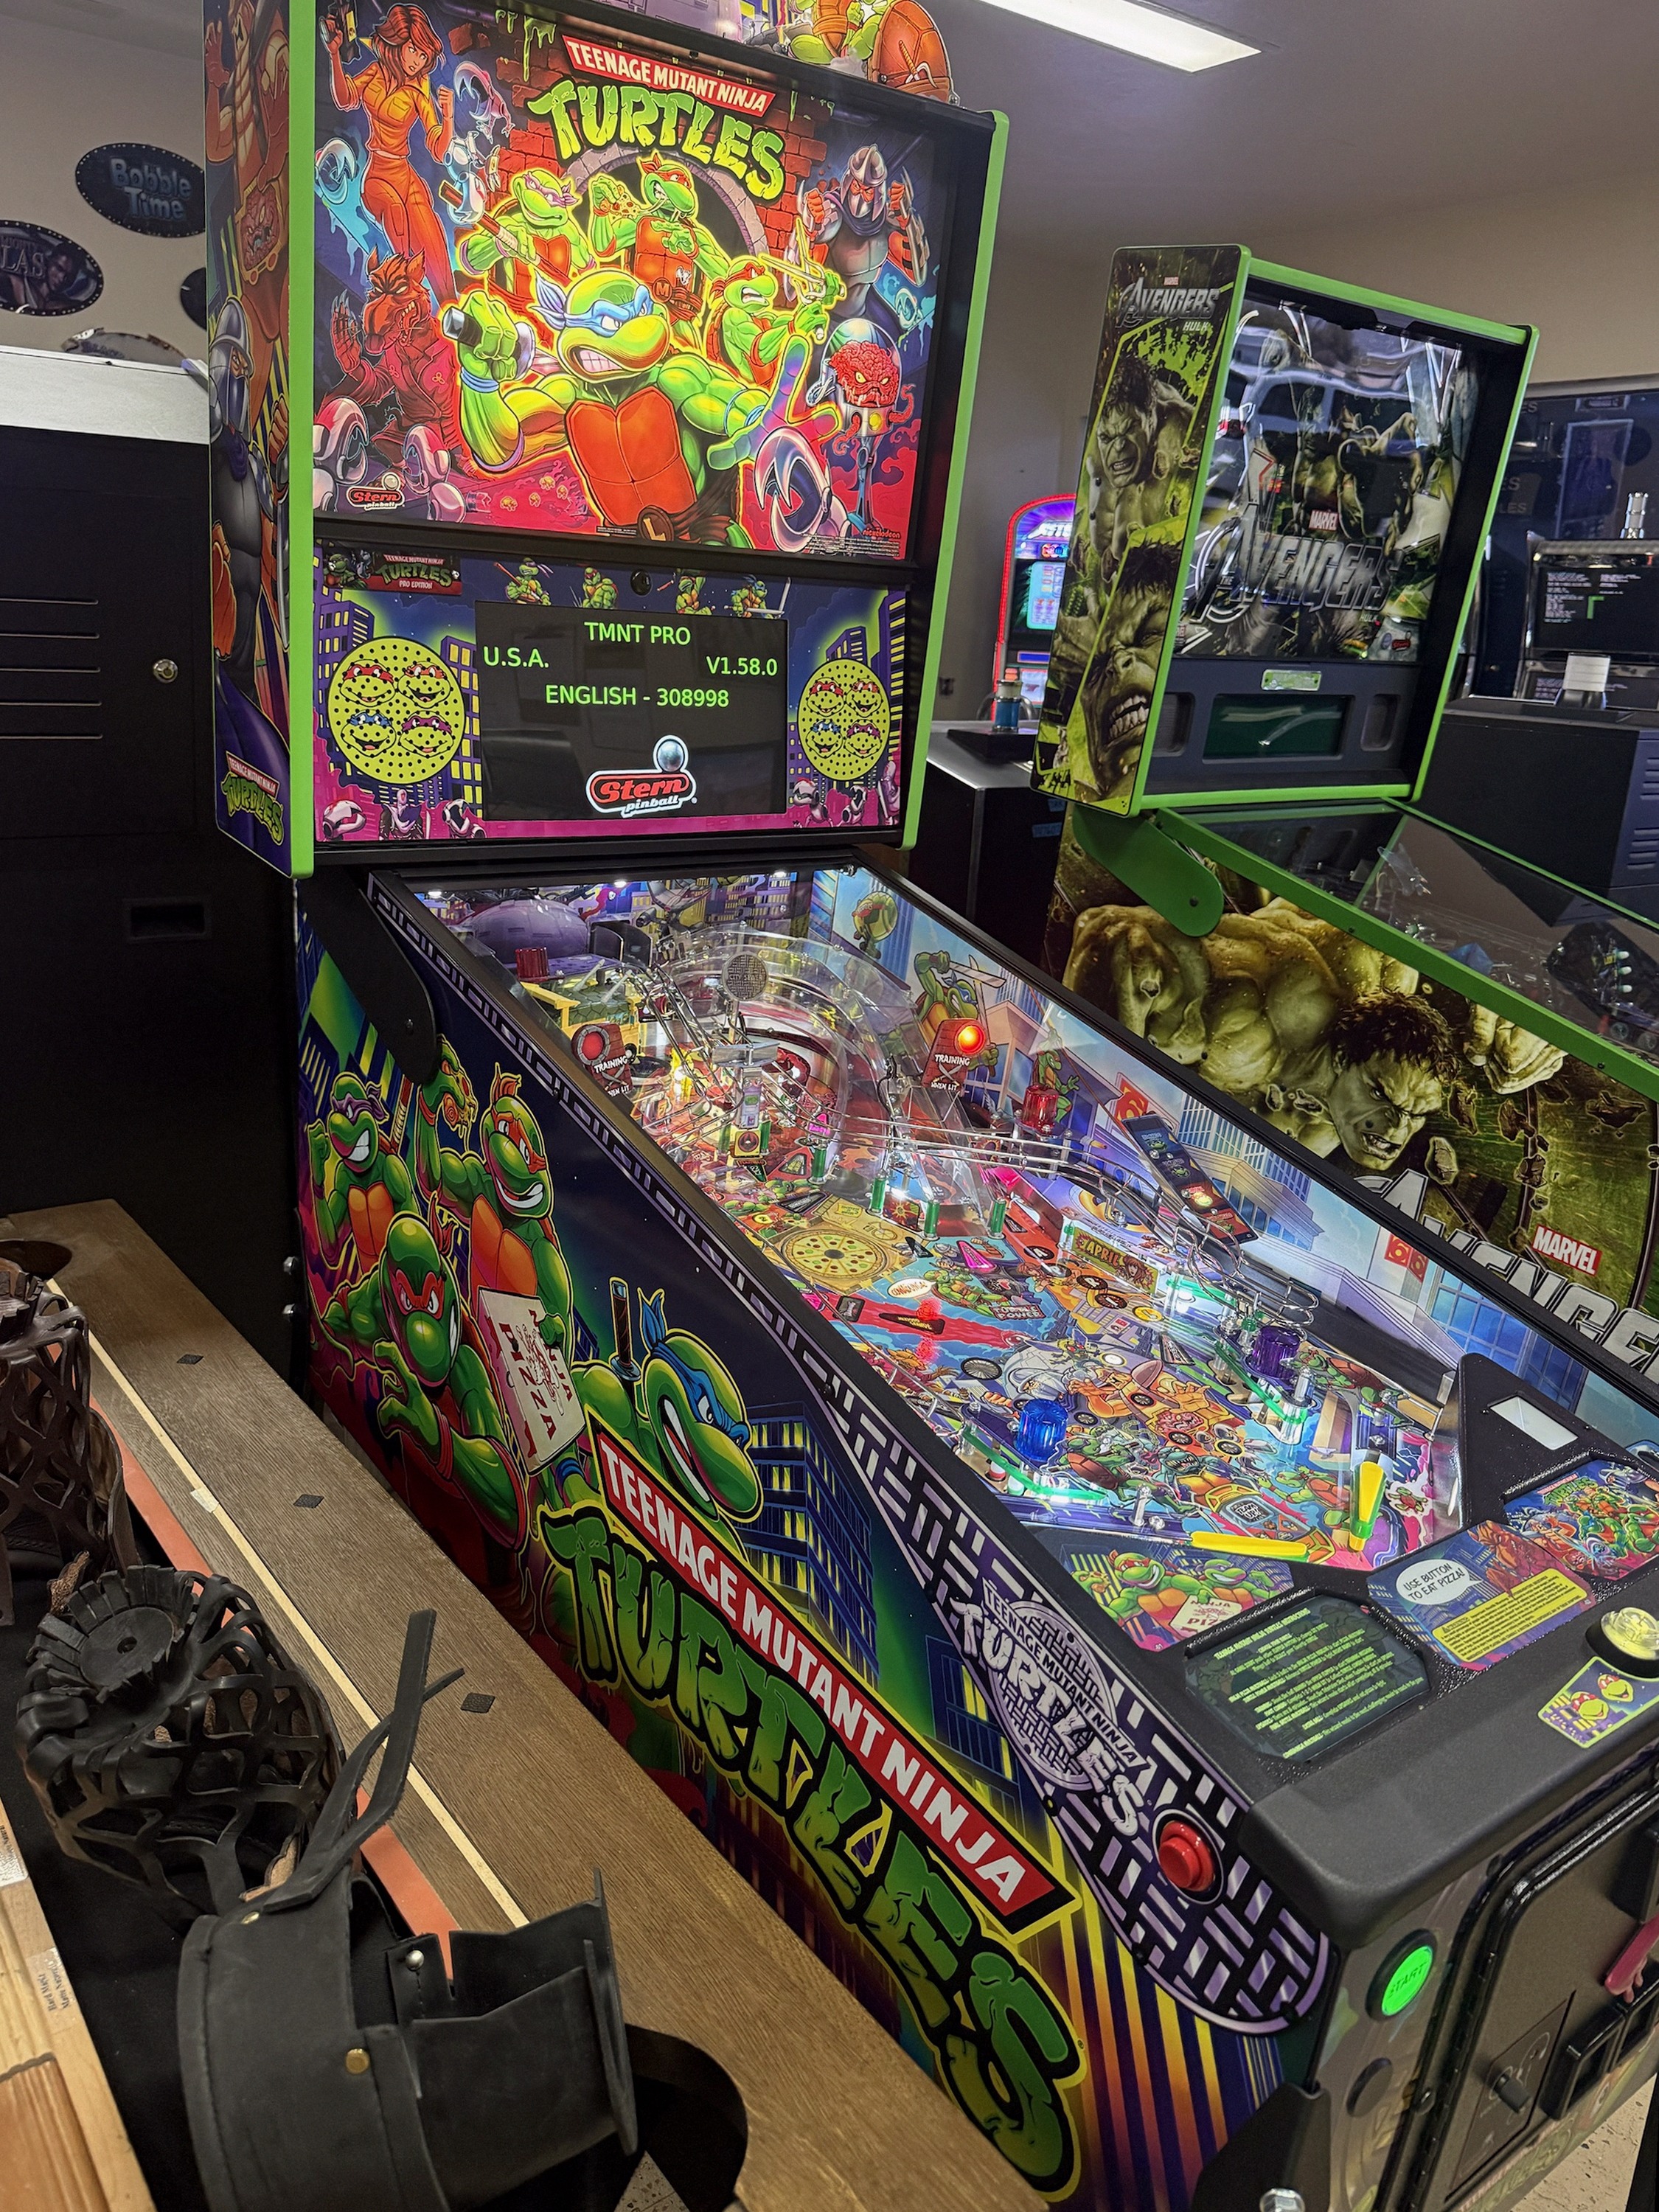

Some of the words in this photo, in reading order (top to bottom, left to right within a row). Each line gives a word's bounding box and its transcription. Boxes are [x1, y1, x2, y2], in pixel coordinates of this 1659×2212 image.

[567, 41, 651, 83] TEENAGE
[654, 67, 717, 99] MUTANT
[717, 83, 768, 111] NINJA
[527, 80, 784, 200] TURTLES
[111, 159, 192, 199] Bobble
[124, 186, 184, 219] Time
[1183, 322, 1208, 332] HULK
[353, 491, 402, 502] Stern
[1309, 510, 1338, 531] MARVEL
[375, 563, 453, 587] TURTLES
[399, 580, 411, 588] PRO
[411, 581, 433, 589] EDITION
[584, 622, 644, 643] TMNT
[650, 625, 691, 646] PRO
[483, 646, 549, 669] U.S.A.
[706, 655, 778, 677] V1.58.0
[546, 684, 637, 706] ENGLISH
[656, 688, 730, 709] 308998
[600, 776, 687, 803] Stern
[222, 776, 282, 844] TURTLES
[625, 796, 681, 813] pinball
[594, 1055, 628, 1074] TRAINING
[934, 1054, 970, 1067] TRAINING
[607, 1088, 622, 1098] HEN
[948, 1083, 958, 1091] LIT
[1087, 1241, 1119, 1267] APRIL
[1534, 1225, 1599, 1276] MARVEL
[498, 1322, 557, 1440] PIZZA
[1402, 1576, 1421, 1591] USE
[1422, 1562, 1453, 1585] BUTTON
[1408, 1590, 1423, 1601] TO
[1422, 1582, 1440, 1596] EAT
[1439, 1568, 1465, 1590] PIZZA!
[599, 1439, 738, 1619] TEENAGE
[742, 1596, 886, 1758] MUTANT
[880, 1740, 1028, 1903] NINJA
[987, 1585, 1042, 1662] TEENAGE
[1035, 1654, 1096, 1717] MUTANT
[1091, 1709, 1139, 1765] NINJA
[952, 1598, 1146, 1837] TURTLES
[543, 1510, 1070, 2180] TURTLES
[1388, 1961, 1429, 1999] START
